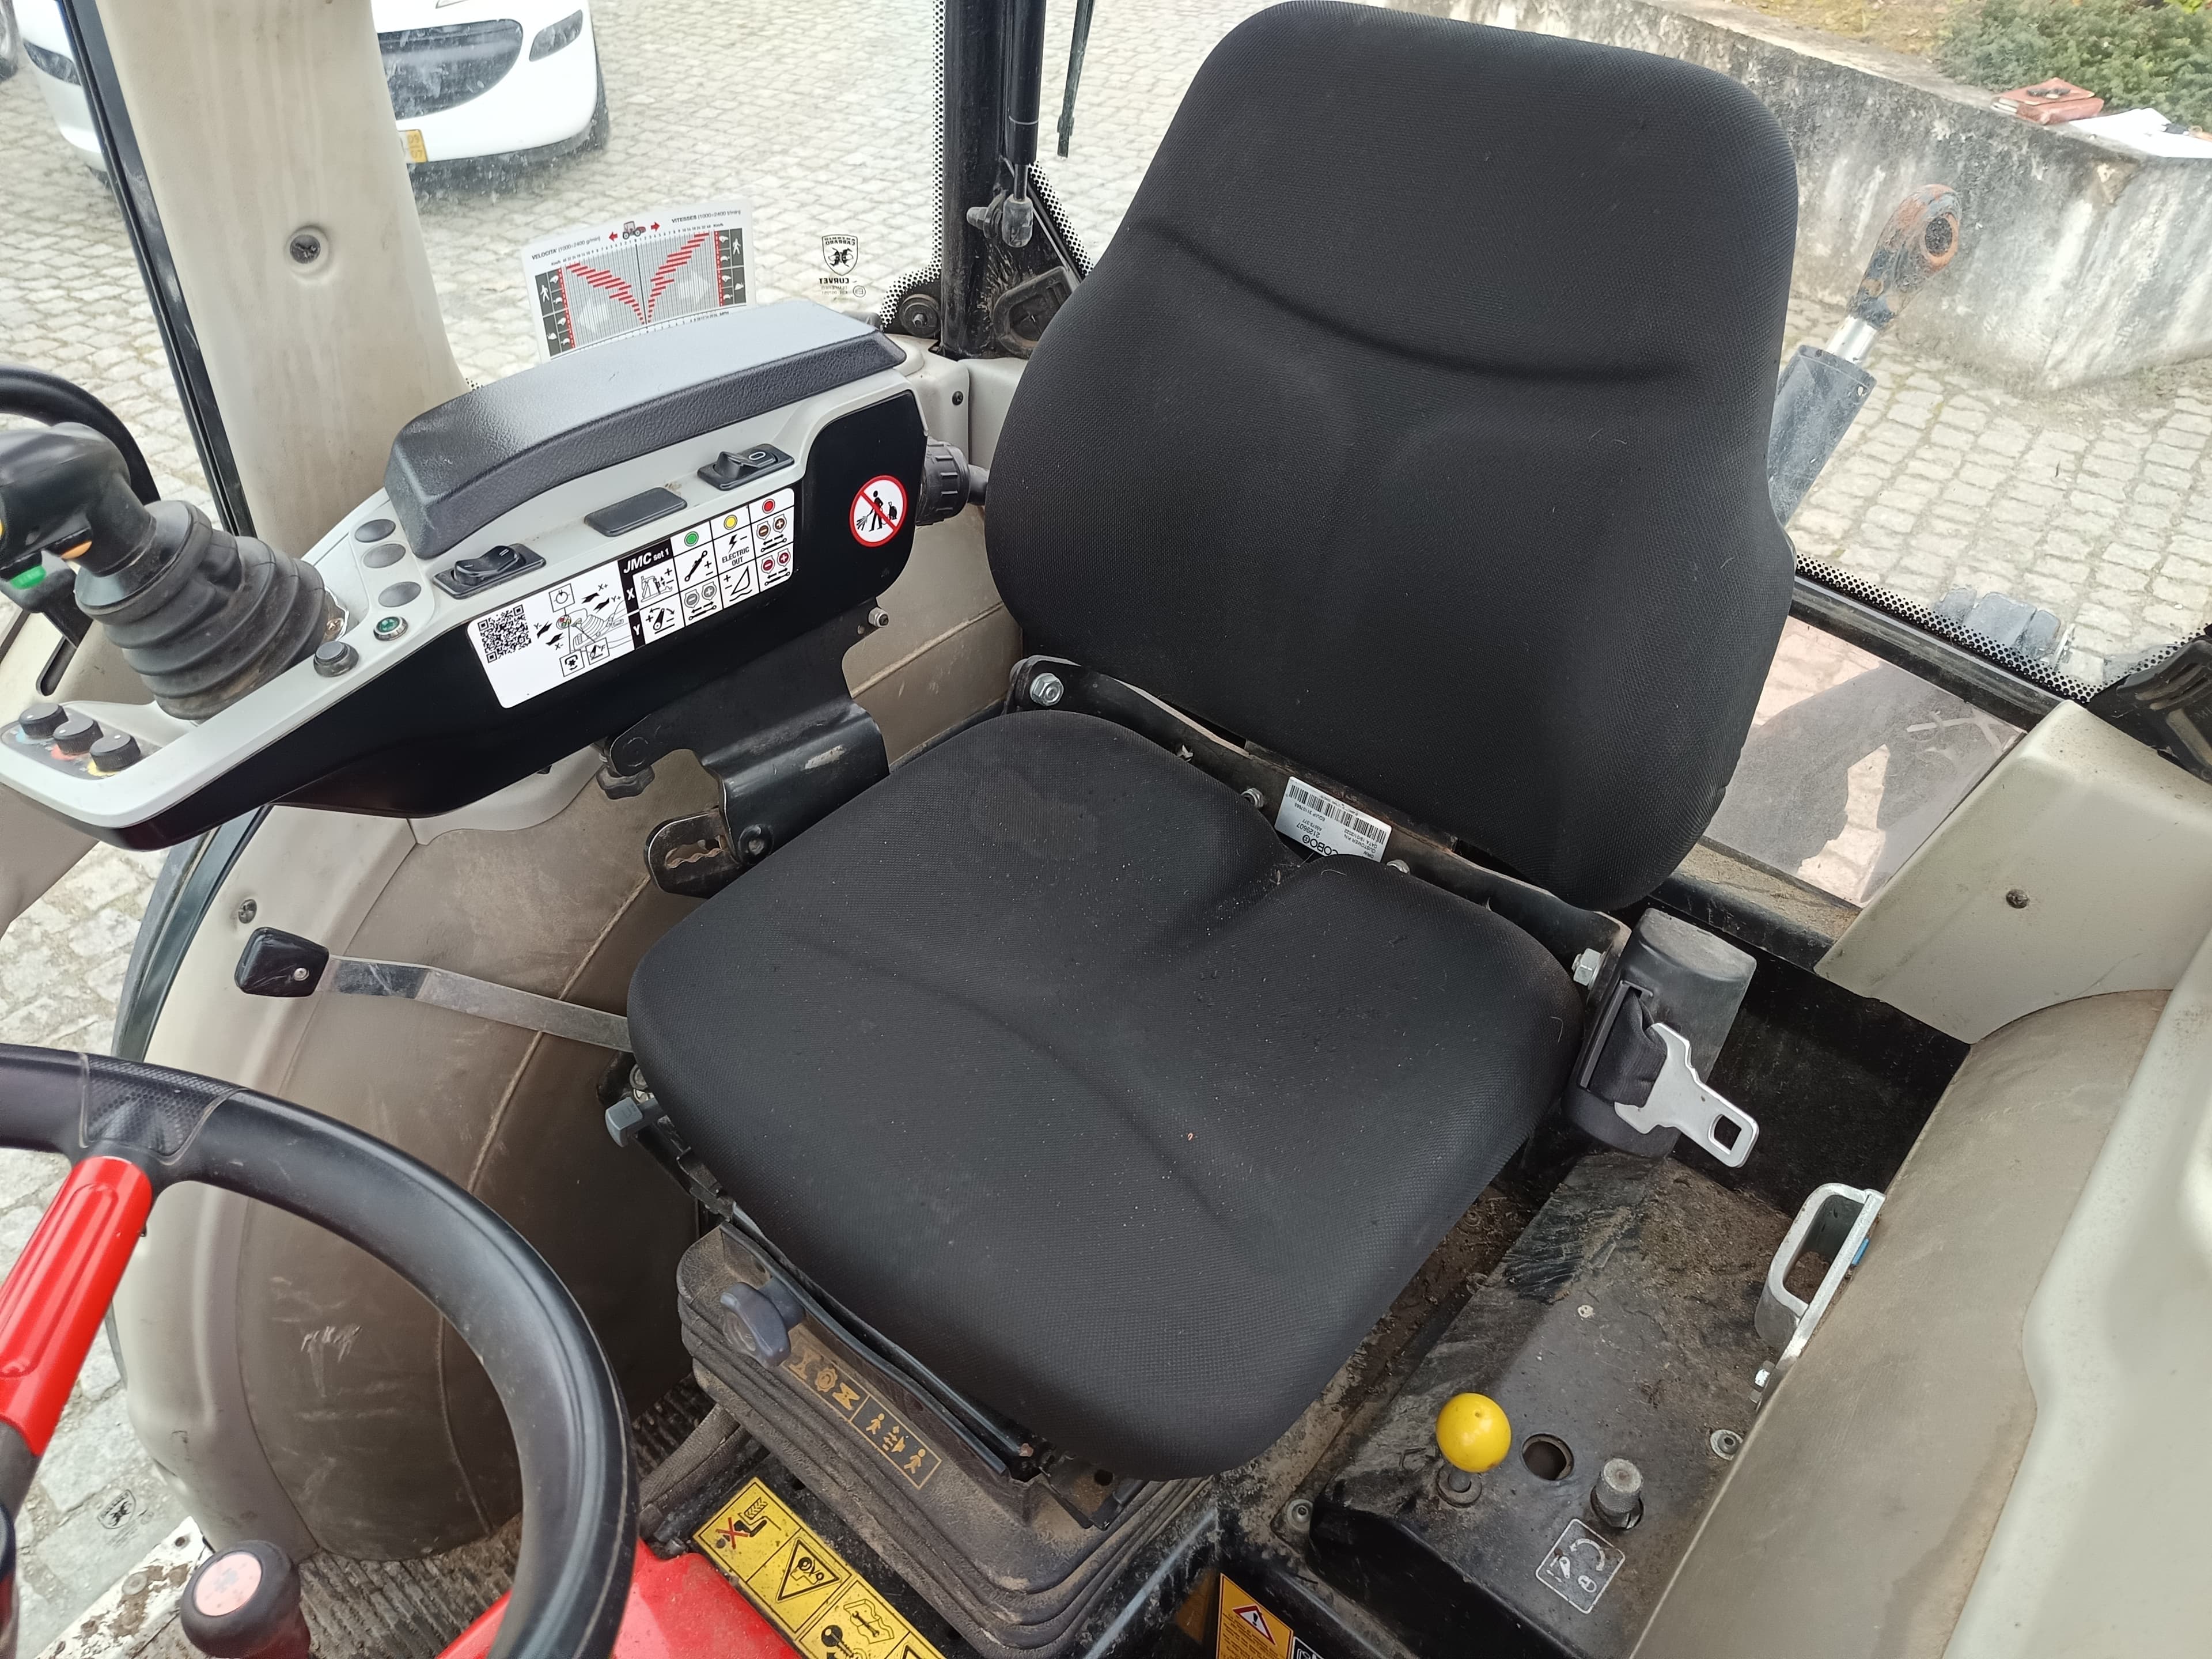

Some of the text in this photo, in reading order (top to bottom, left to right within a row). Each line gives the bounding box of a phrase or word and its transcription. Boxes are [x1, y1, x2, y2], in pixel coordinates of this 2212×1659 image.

[672, 215, 697, 223] VITESSES
[722, 546, 750, 563] ELECTRIC
[623, 552, 652, 573] JMC
[653, 551, 664, 561] set
[732, 556, 744, 566] OUT
[626, 588, 635, 600] X
[632, 624, 641, 635] Y
[1312, 812, 1325, 822] EQUIP
[1296, 823, 1321, 839] 2129607
[1351, 838, 1376, 853] CUSTOMER
[1366, 840, 1377, 849] DATA
